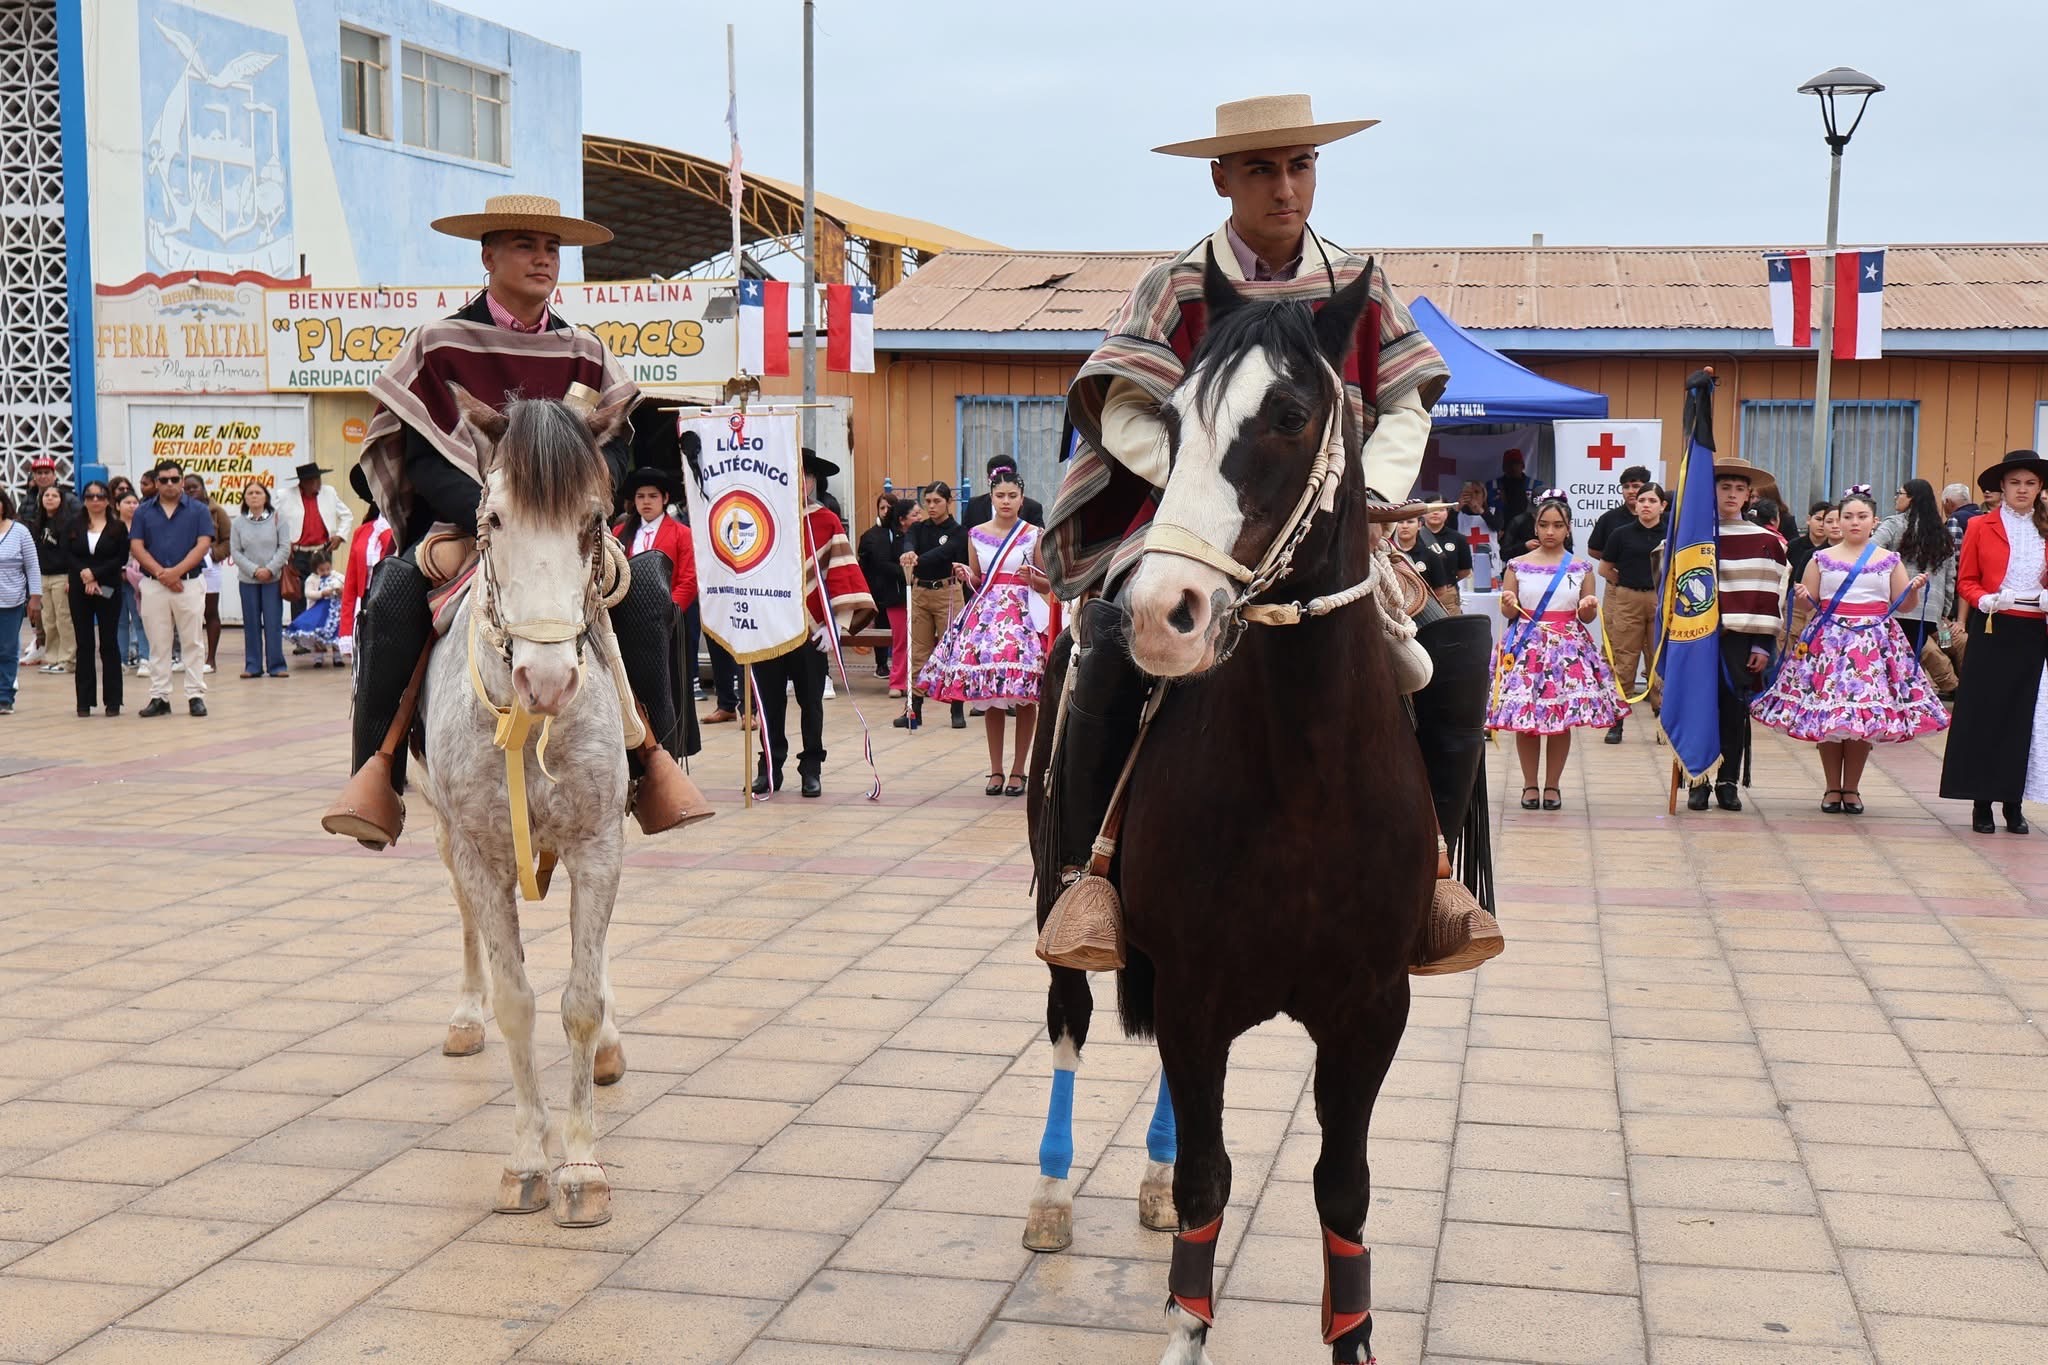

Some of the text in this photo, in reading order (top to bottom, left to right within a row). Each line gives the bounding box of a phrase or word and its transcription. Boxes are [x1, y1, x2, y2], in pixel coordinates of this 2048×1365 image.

[289, 291, 418, 309] BIENVENIDOS
[437, 291, 446, 308] A
[583, 284, 692, 304] TALTALINA
[97, 323, 266, 358] FERIA TALTAL
[1449, 403, 1459, 417] DE
[1460, 403, 1486, 416] TALTAL
[152, 421, 261, 440] ROPA DE NIÑOS
[153, 438, 295, 457] VESTUARIO DE MUJER
[703, 455, 788, 486] OLITÉCNICO
[1569, 483, 1604, 495] CRUZ
[1577, 499, 1623, 510] CHILEN
[749, 588, 791, 599] VILLALOBOS
